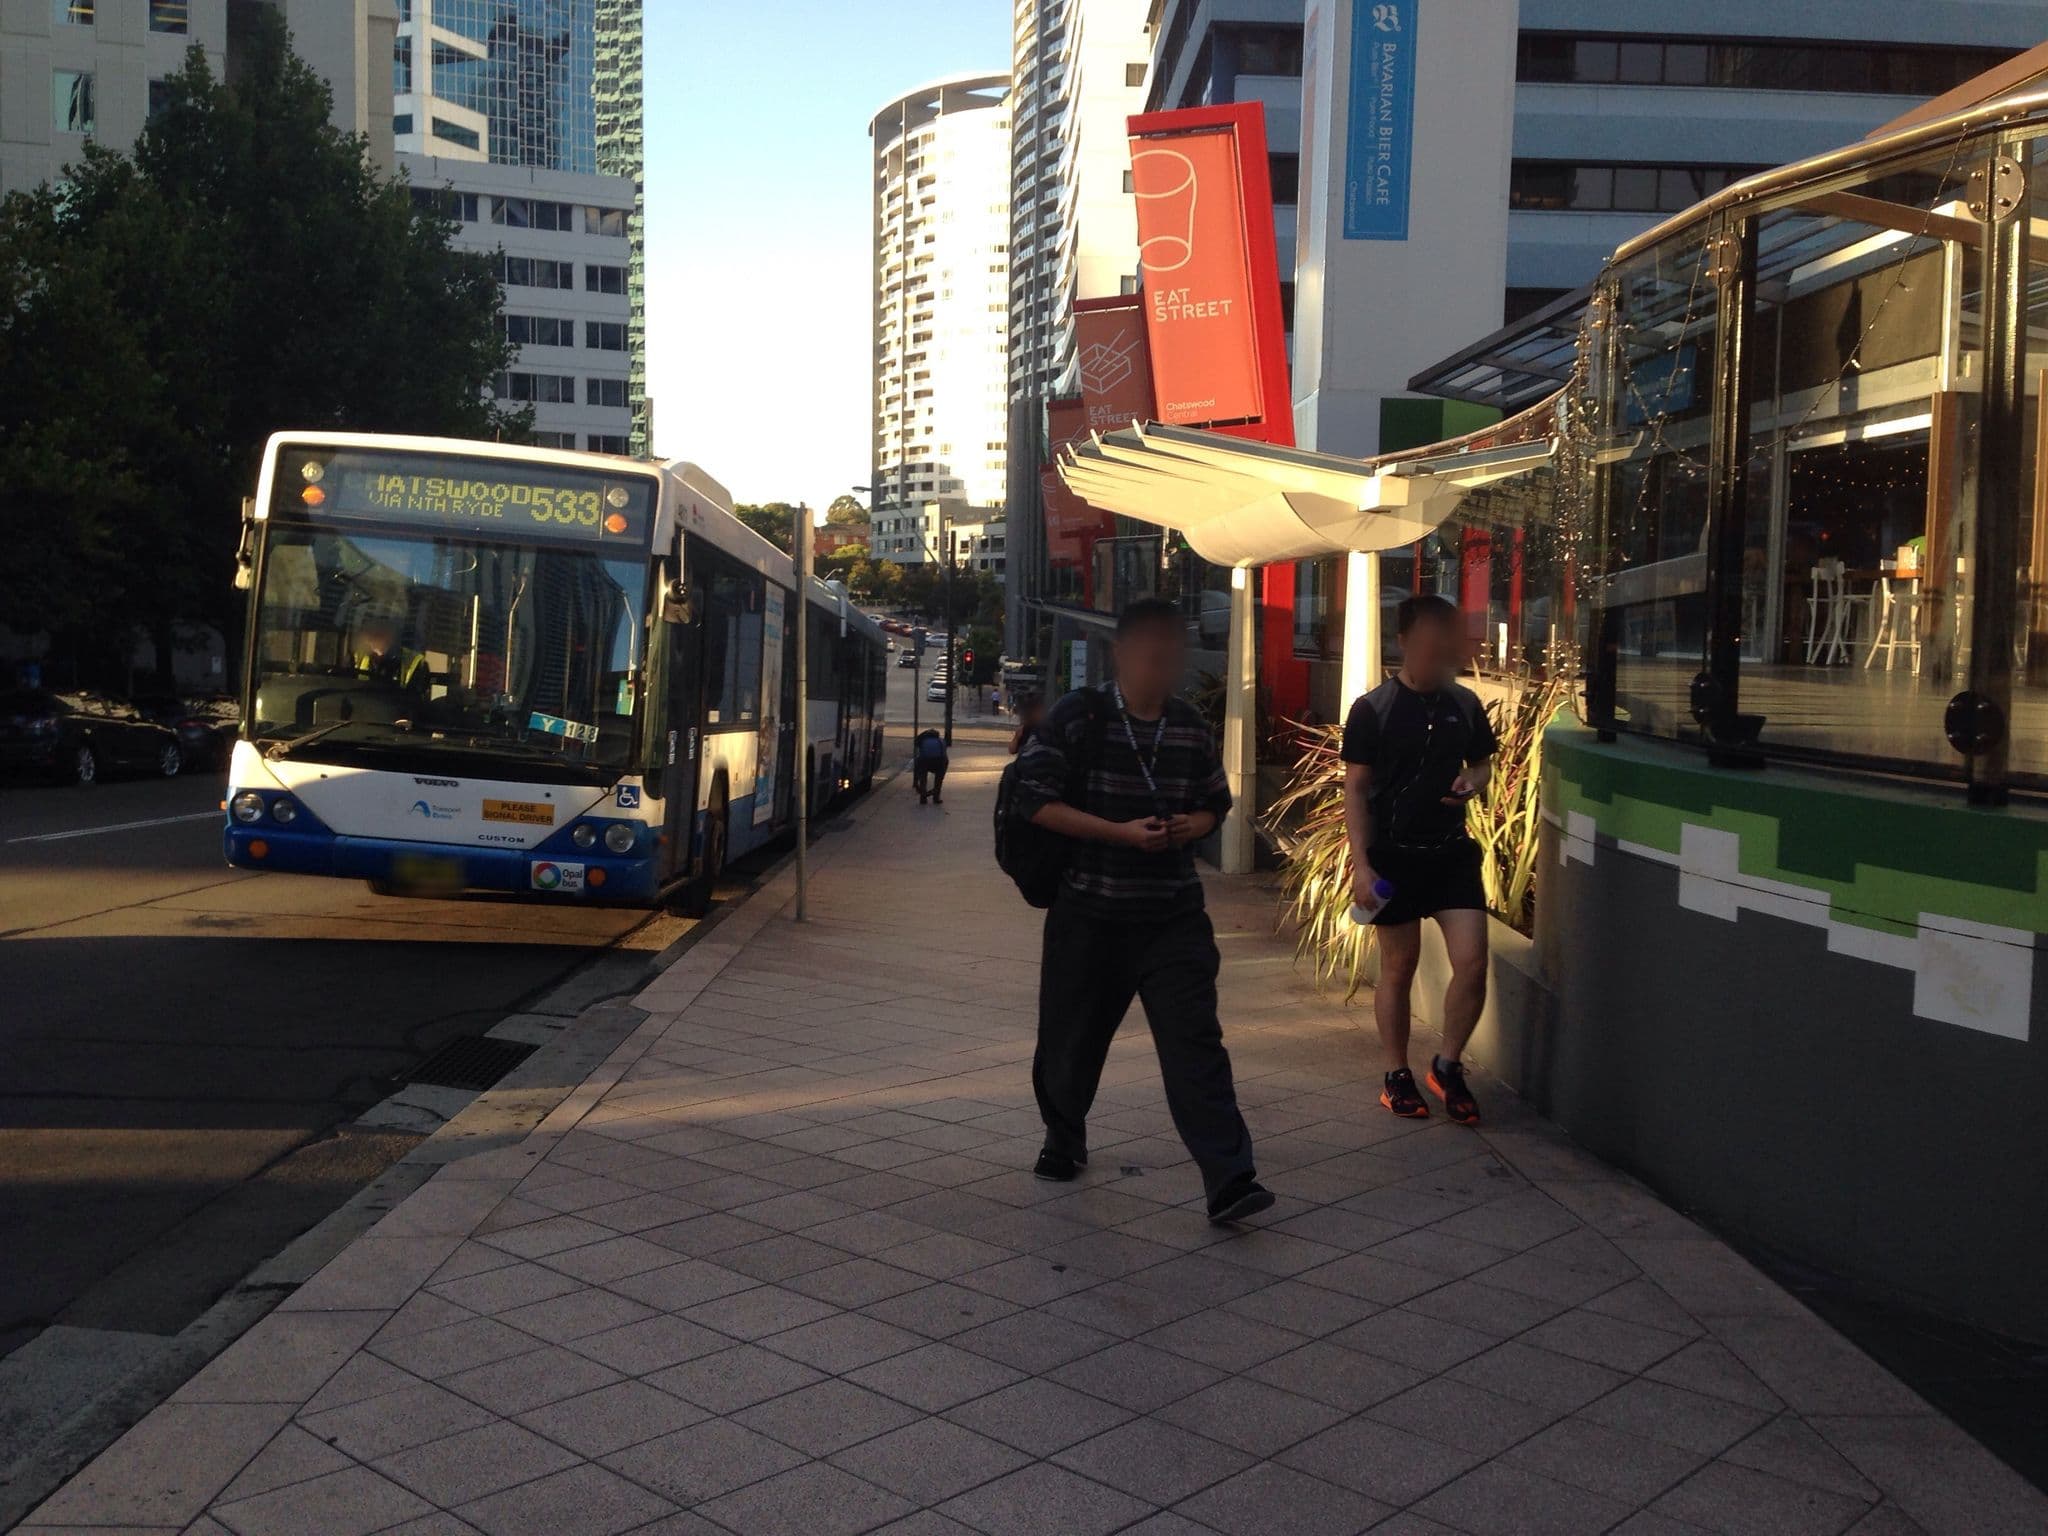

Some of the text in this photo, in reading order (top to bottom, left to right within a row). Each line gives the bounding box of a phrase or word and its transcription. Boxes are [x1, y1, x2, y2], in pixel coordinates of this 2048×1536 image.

[1379, 43, 1397, 121] BAVARIAN
[1378, 127, 1393, 162] BIER
[1153, 287, 1191, 306] EAT
[1155, 299, 1233, 322] STREET
[1088, 404, 1113, 417] EAT
[1165, 398, 1216, 411] Chatswood
[1089, 411, 1139, 426] STREET
[1167, 409, 1199, 419] Central
[368, 491, 504, 518] VIA NTH RYDE
[530, 488, 600, 526] 533
[541, 717, 556, 733] Y
[413, 777, 460, 788] VOLVO
[500, 803, 537, 813] PLEASE
[518, 812, 554, 823] DRIVER
[477, 834, 526, 843] CUSTOM
[562, 868, 584, 879] Opal
[561, 878, 579, 888] bus
